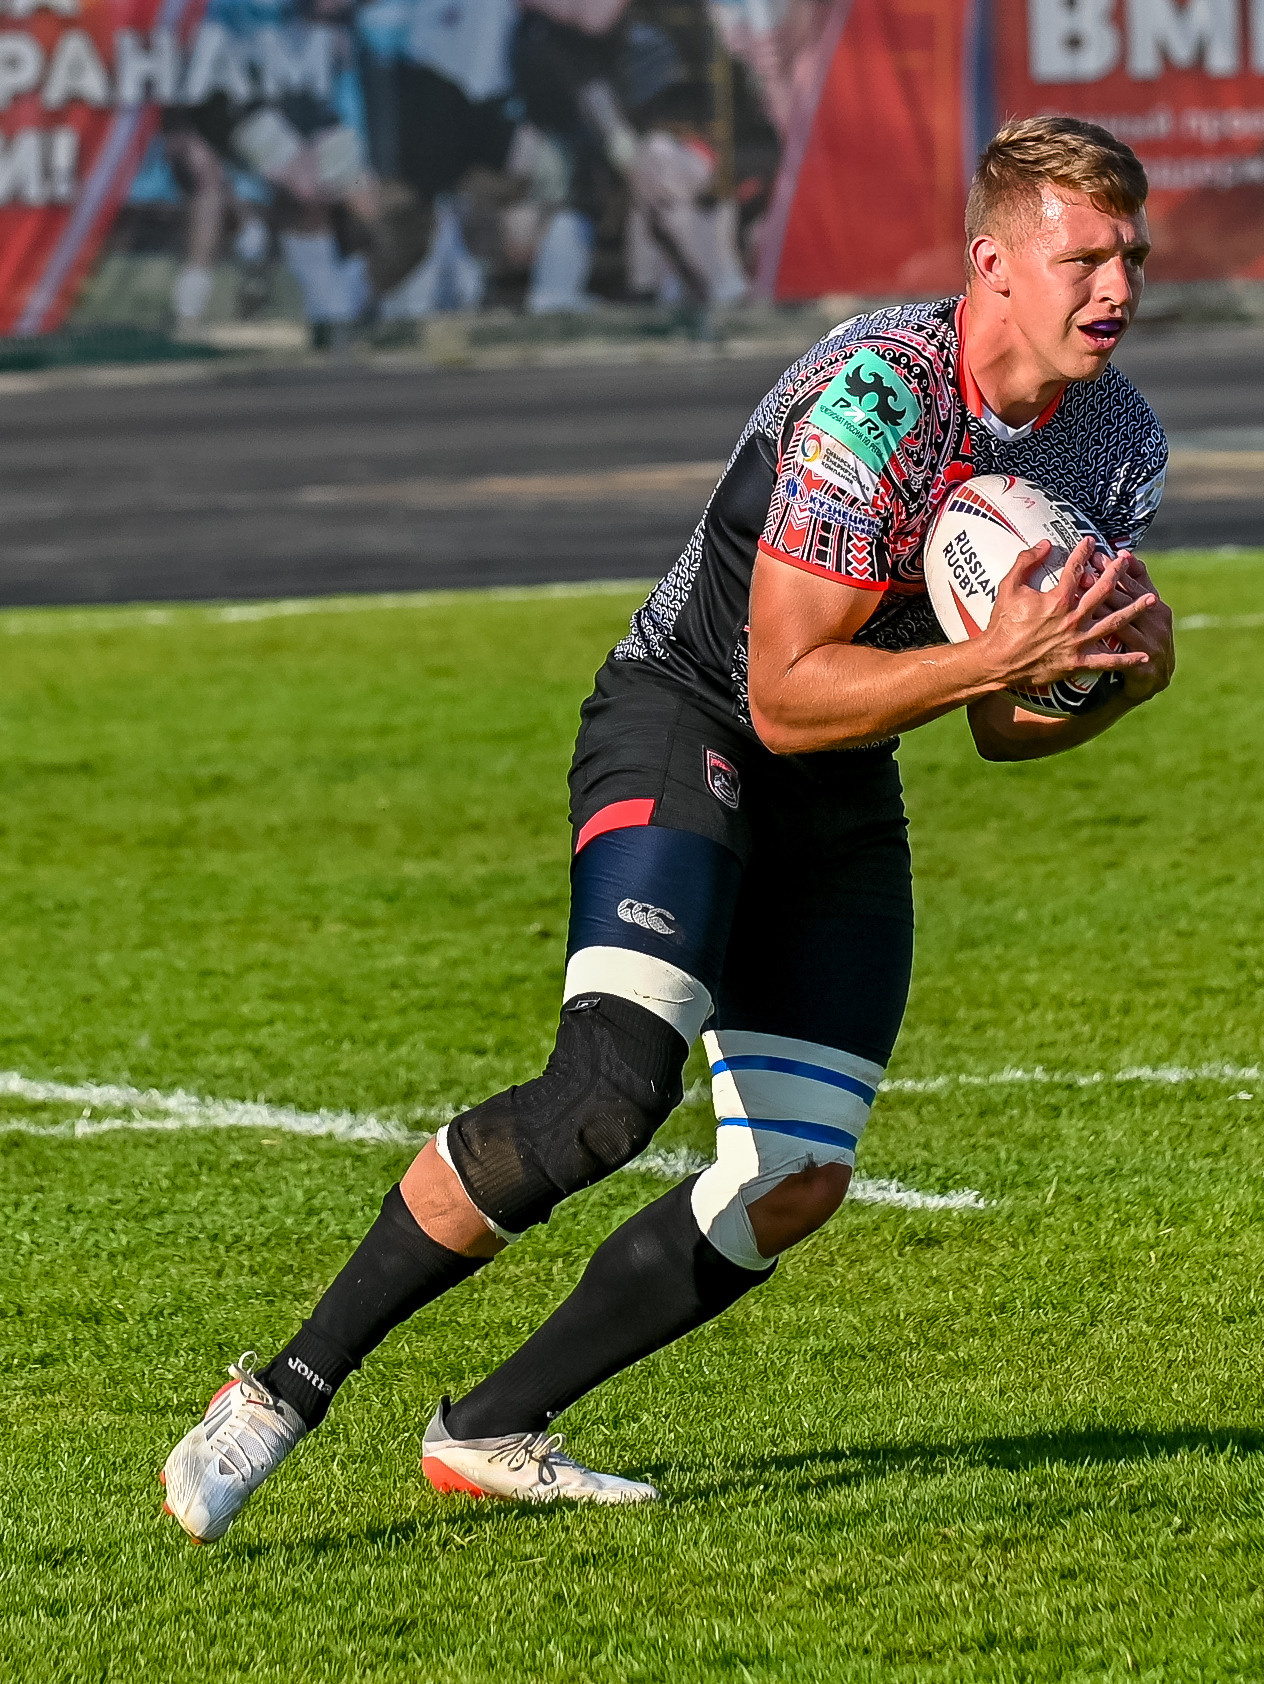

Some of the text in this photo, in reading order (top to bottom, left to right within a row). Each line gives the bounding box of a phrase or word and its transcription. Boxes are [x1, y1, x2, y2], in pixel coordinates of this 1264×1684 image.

[821, 461, 854, 486] КОМПАНИЯ
[942, 540, 980, 599] RUGBY
[954, 529, 997, 604] RUSSIAN
